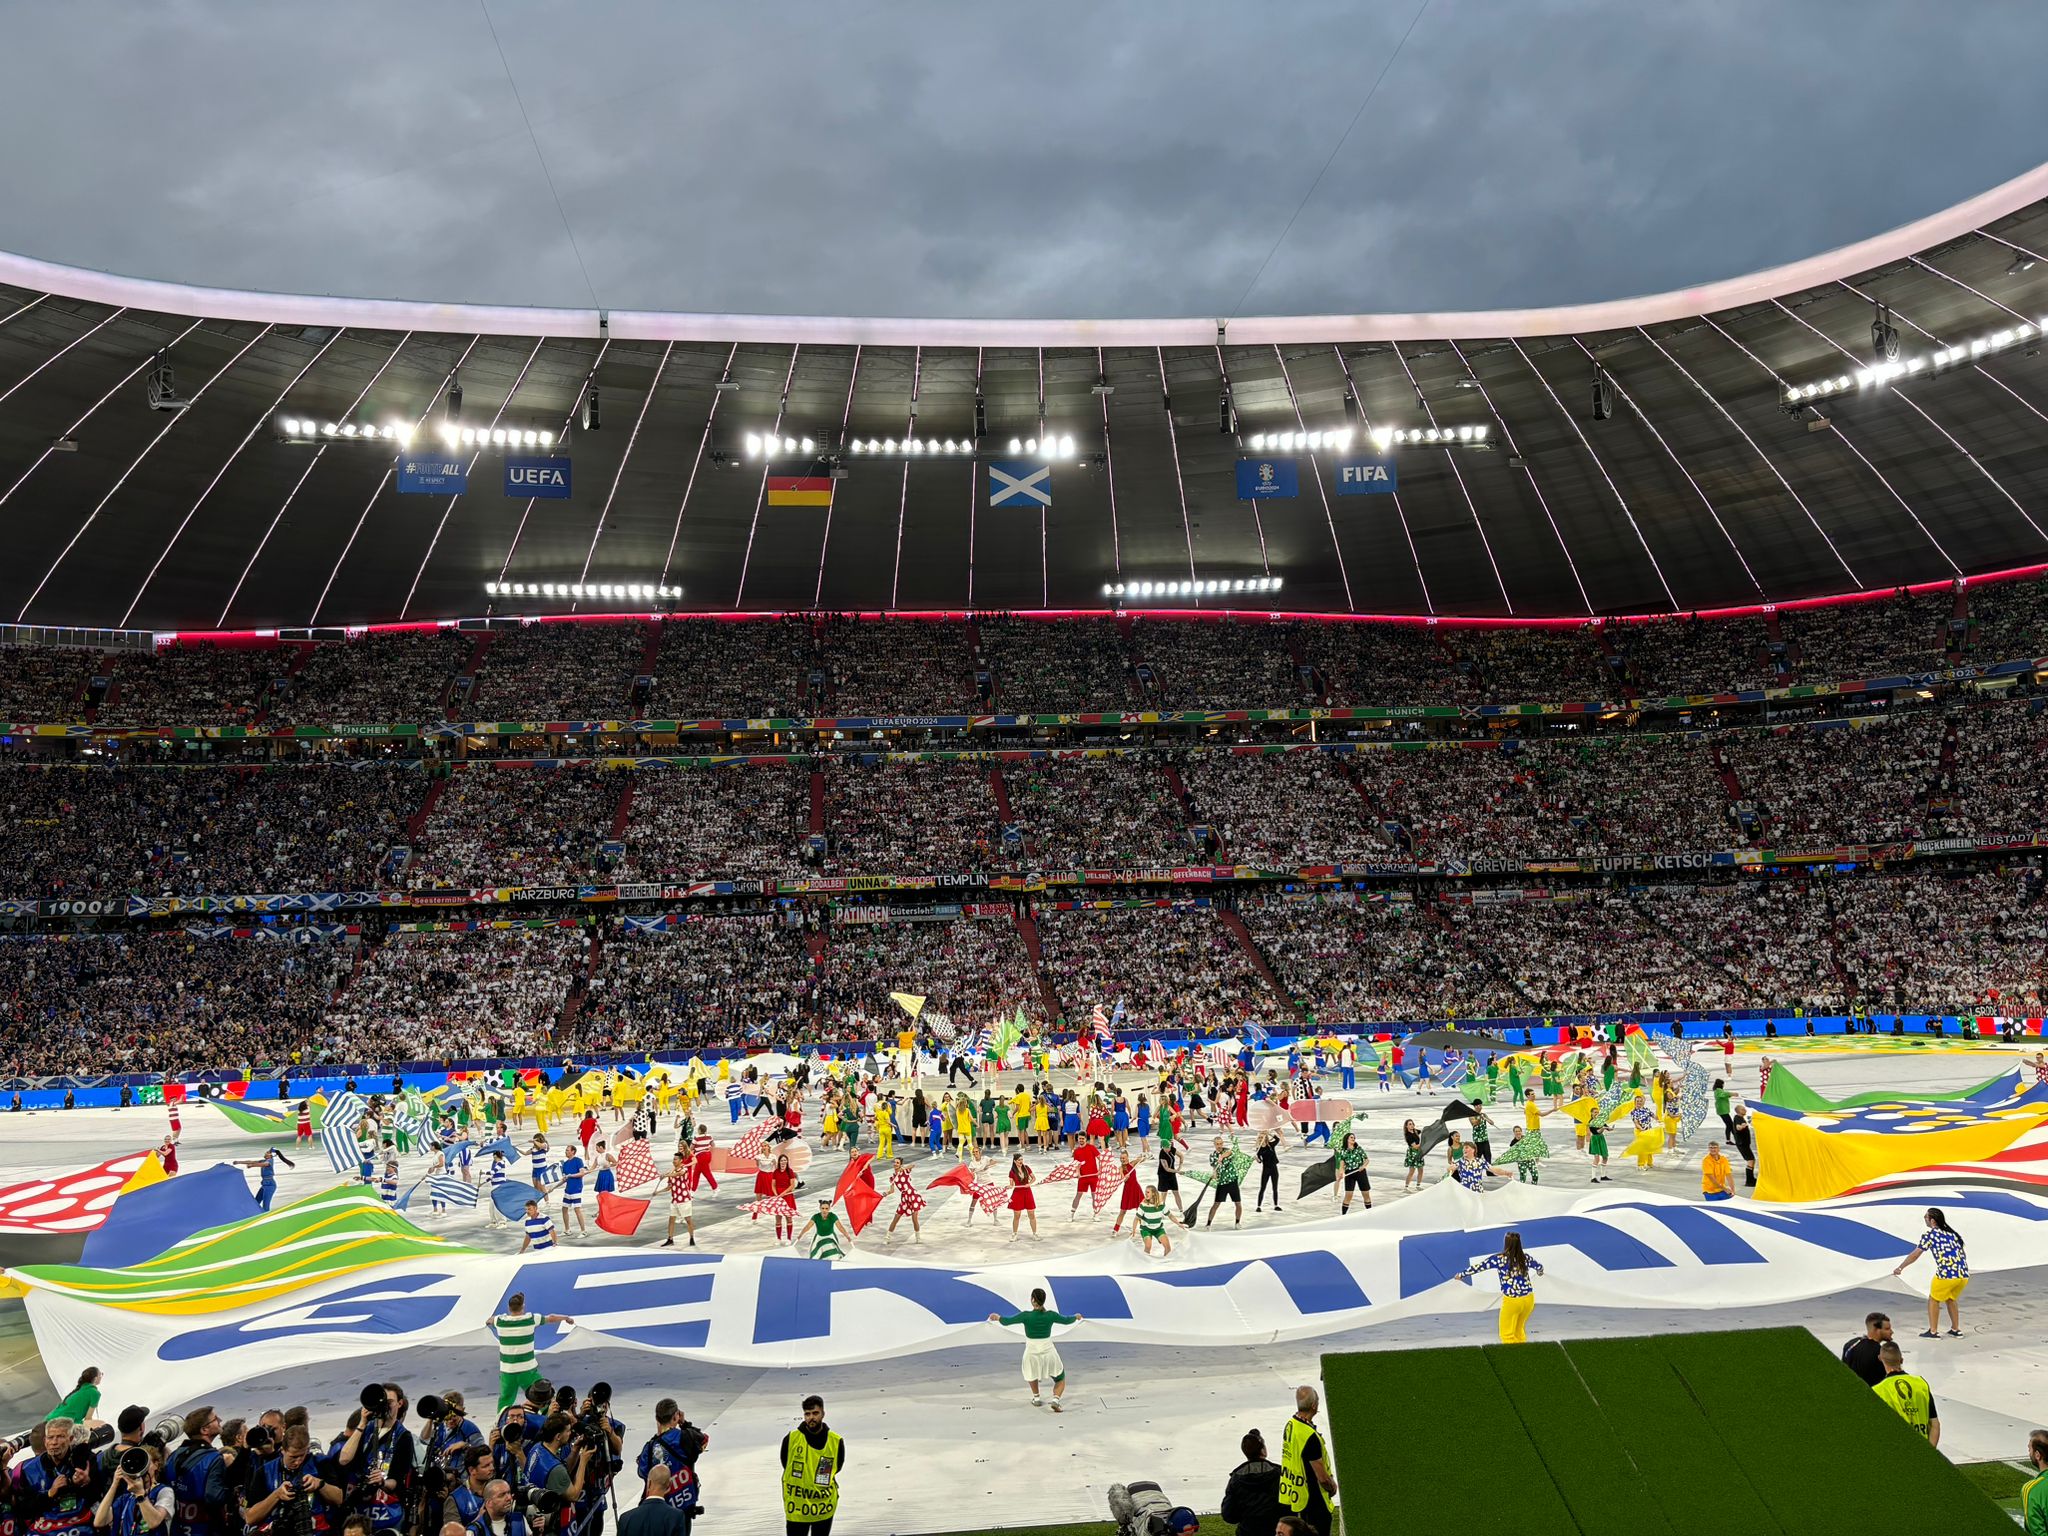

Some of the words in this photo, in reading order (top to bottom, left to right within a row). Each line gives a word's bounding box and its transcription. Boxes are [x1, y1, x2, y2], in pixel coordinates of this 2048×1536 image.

[510, 468, 564, 485] UEFA
[1342, 466, 1388, 483] FIFA
[1386, 708, 1425, 716] MUNICH
[1972, 833, 2031, 846] NEUSTADT
[1776, 847, 1834, 857] HEIDELSHEIM
[1474, 860, 1523, 872] GREVEN
[1593, 856, 1642, 871] FUPPE
[1654, 853, 1713, 869] KETSCH
[936, 874, 989, 886] TEMPLIN
[1173, 870, 1212, 879] OFFENBACH
[850, 878, 880, 889] UNNA
[512, 889, 575, 900] HARZBURG
[48, 900, 103, 915] 1900
